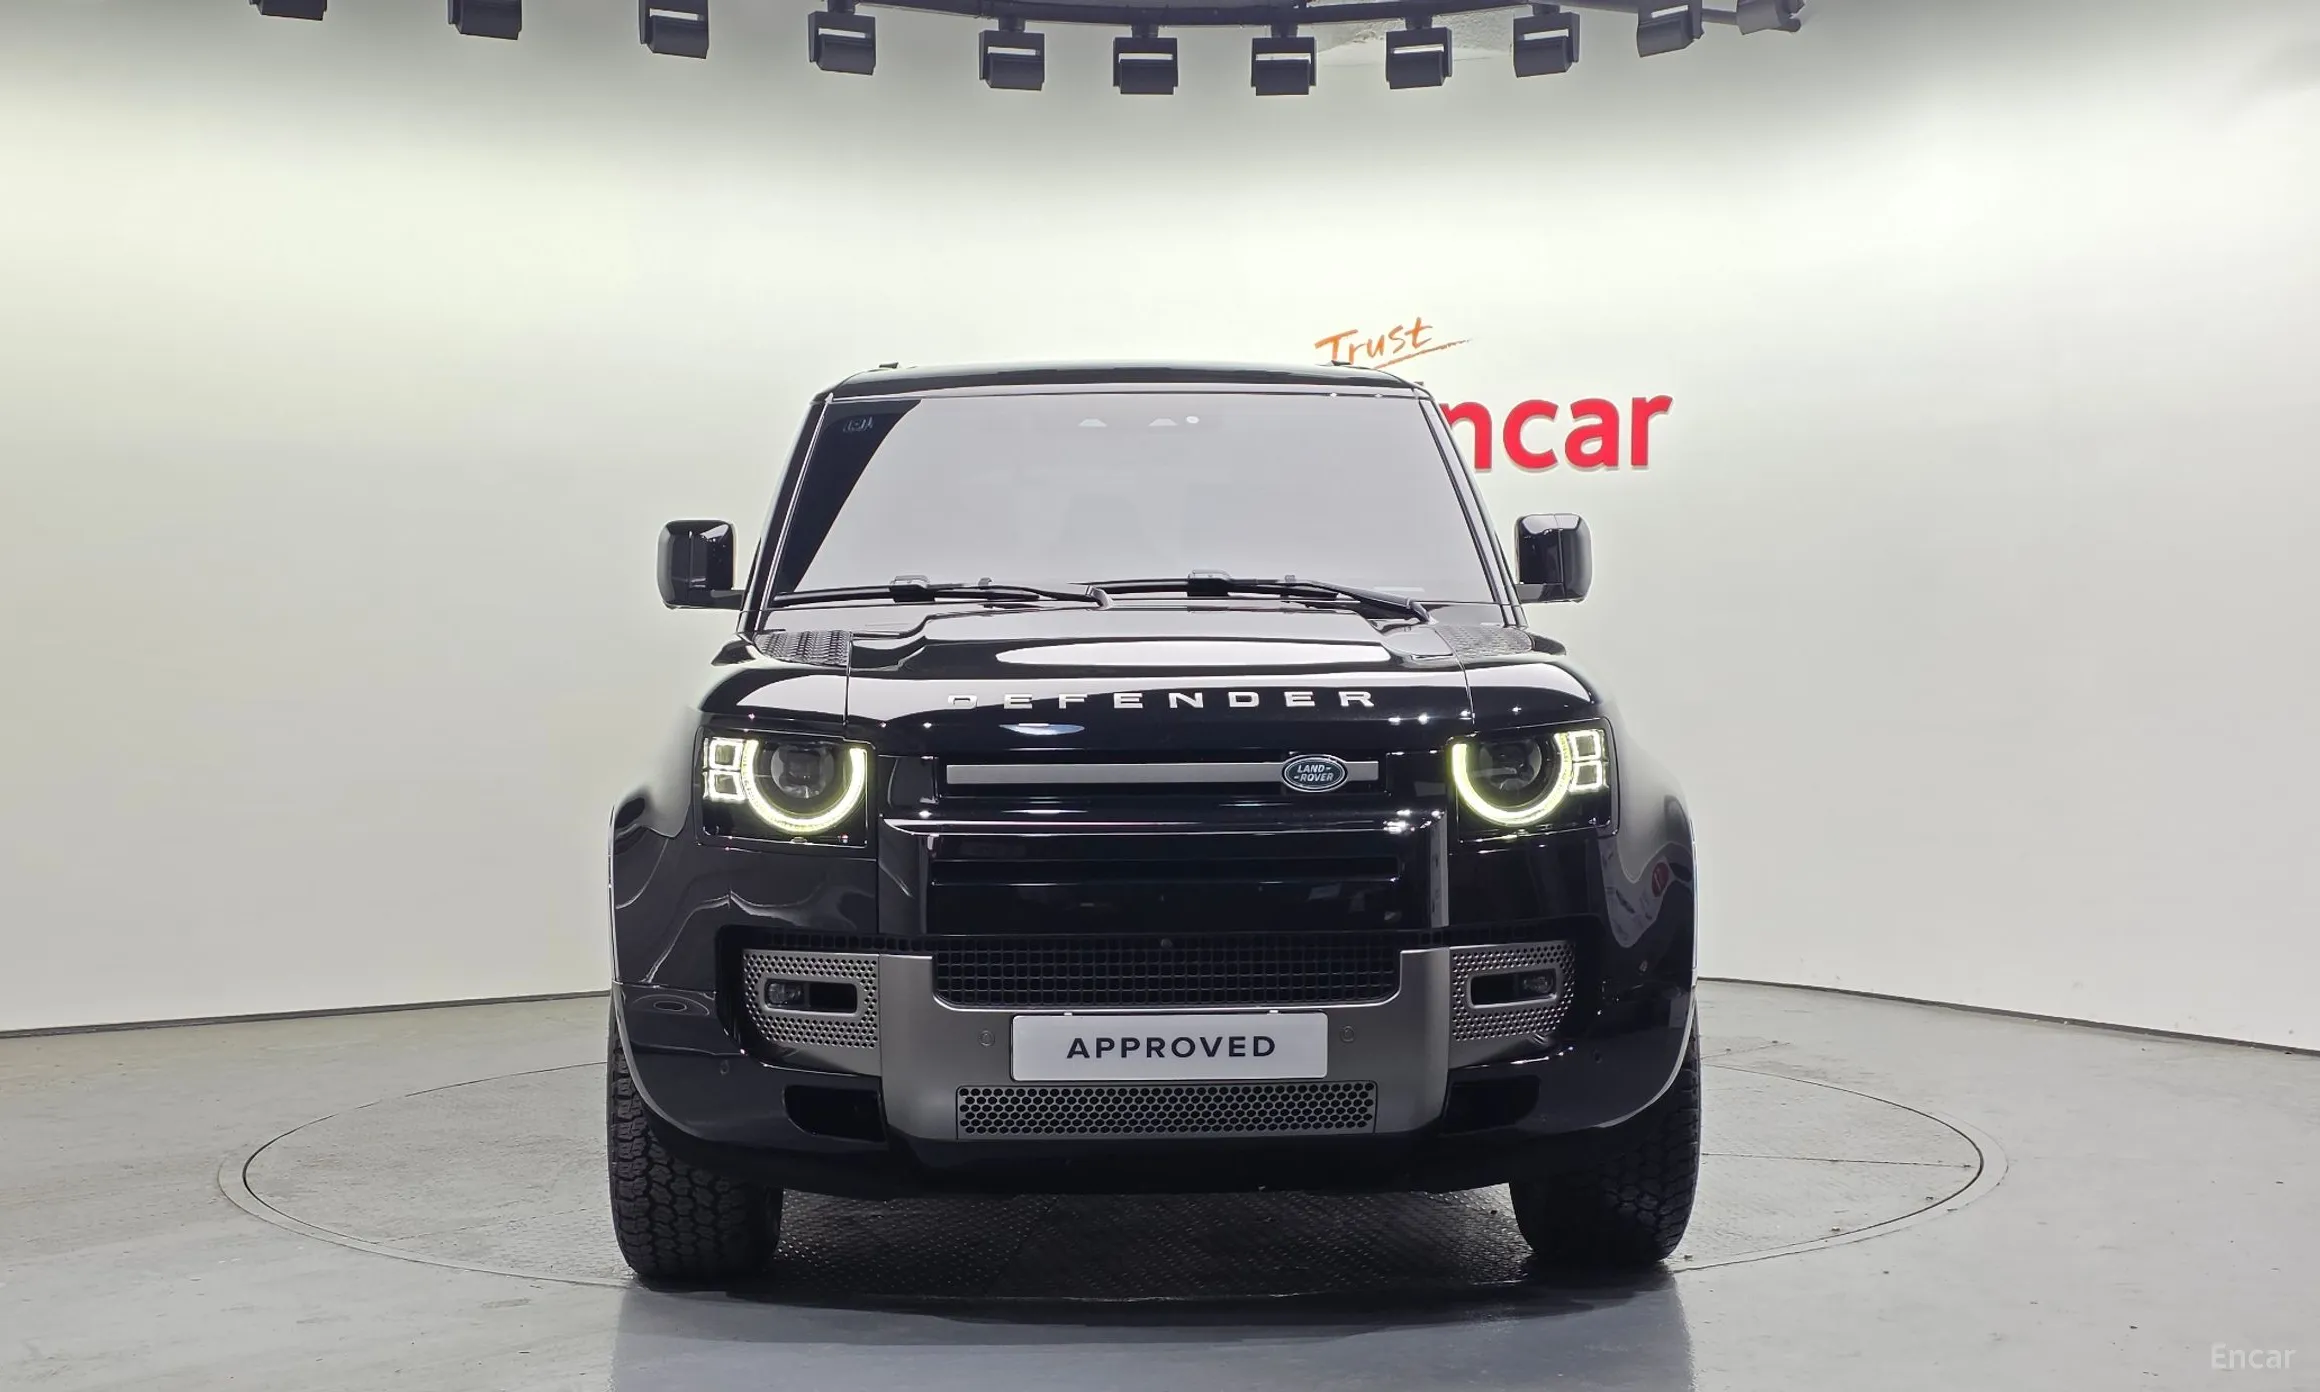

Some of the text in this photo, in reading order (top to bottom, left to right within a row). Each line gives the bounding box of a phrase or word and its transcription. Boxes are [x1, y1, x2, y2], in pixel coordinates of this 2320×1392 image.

[1314, 316, 1434, 365] Trust
[947, 691, 1375, 710] DEFENDER
[1066, 1035, 1277, 1059] APPROVED
